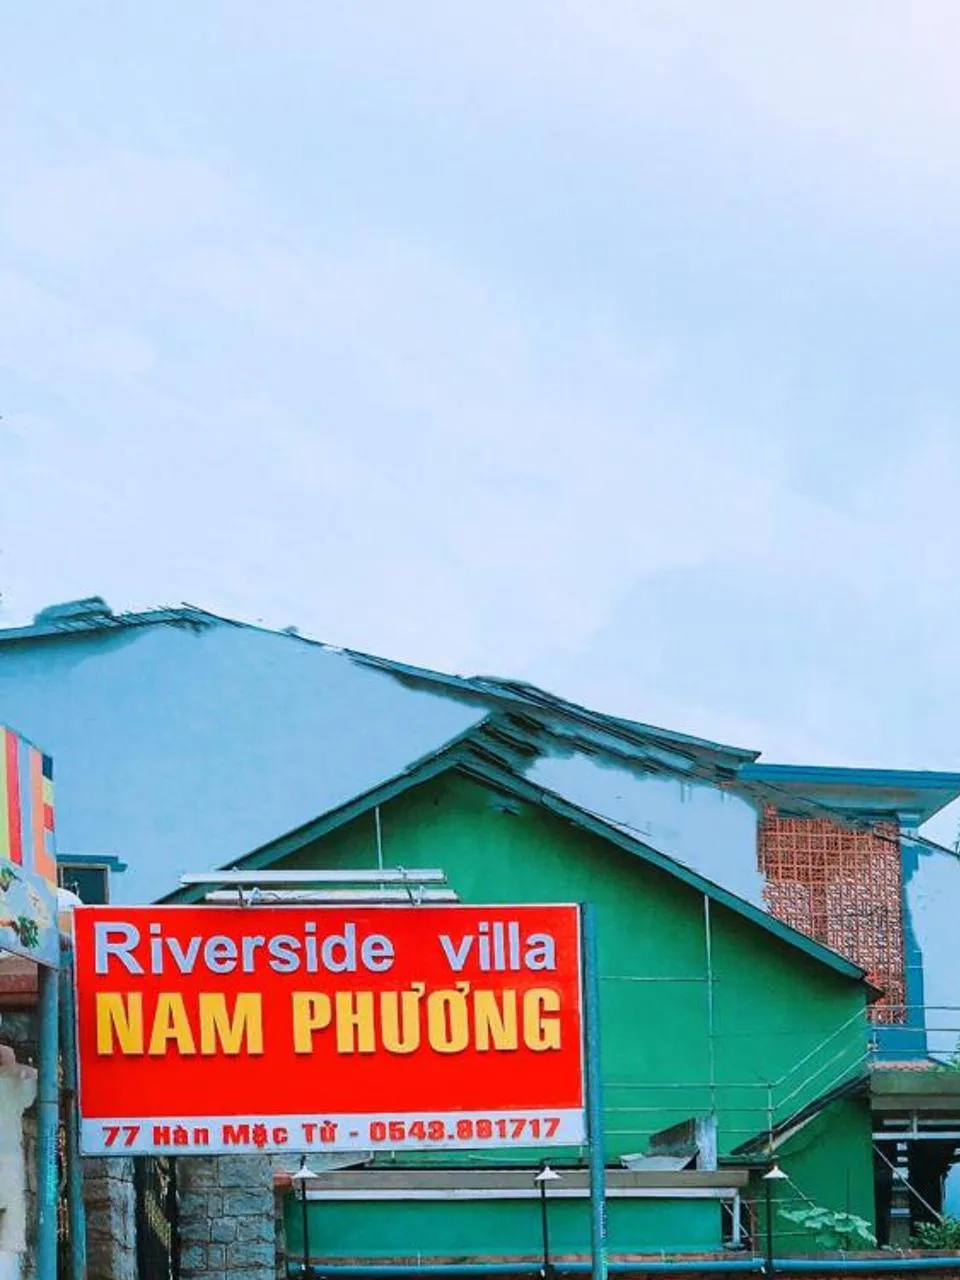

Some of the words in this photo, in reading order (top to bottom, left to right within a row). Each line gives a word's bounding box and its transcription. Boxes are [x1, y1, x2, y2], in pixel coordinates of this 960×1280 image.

[93, 920, 395, 975] Riverside
[438, 920, 556, 972] villa
[95, 991, 265, 1056] NAM
[291, 980, 562, 1054] PHƯƠNG
[102, 1125, 141, 1147] 77
[153, 1124, 210, 1146] Hàn
[222, 1123, 288, 1148] Mặc
[301, 1119, 338, 1145] Tử
[369, 1117, 561, 1142] 0543.881717
